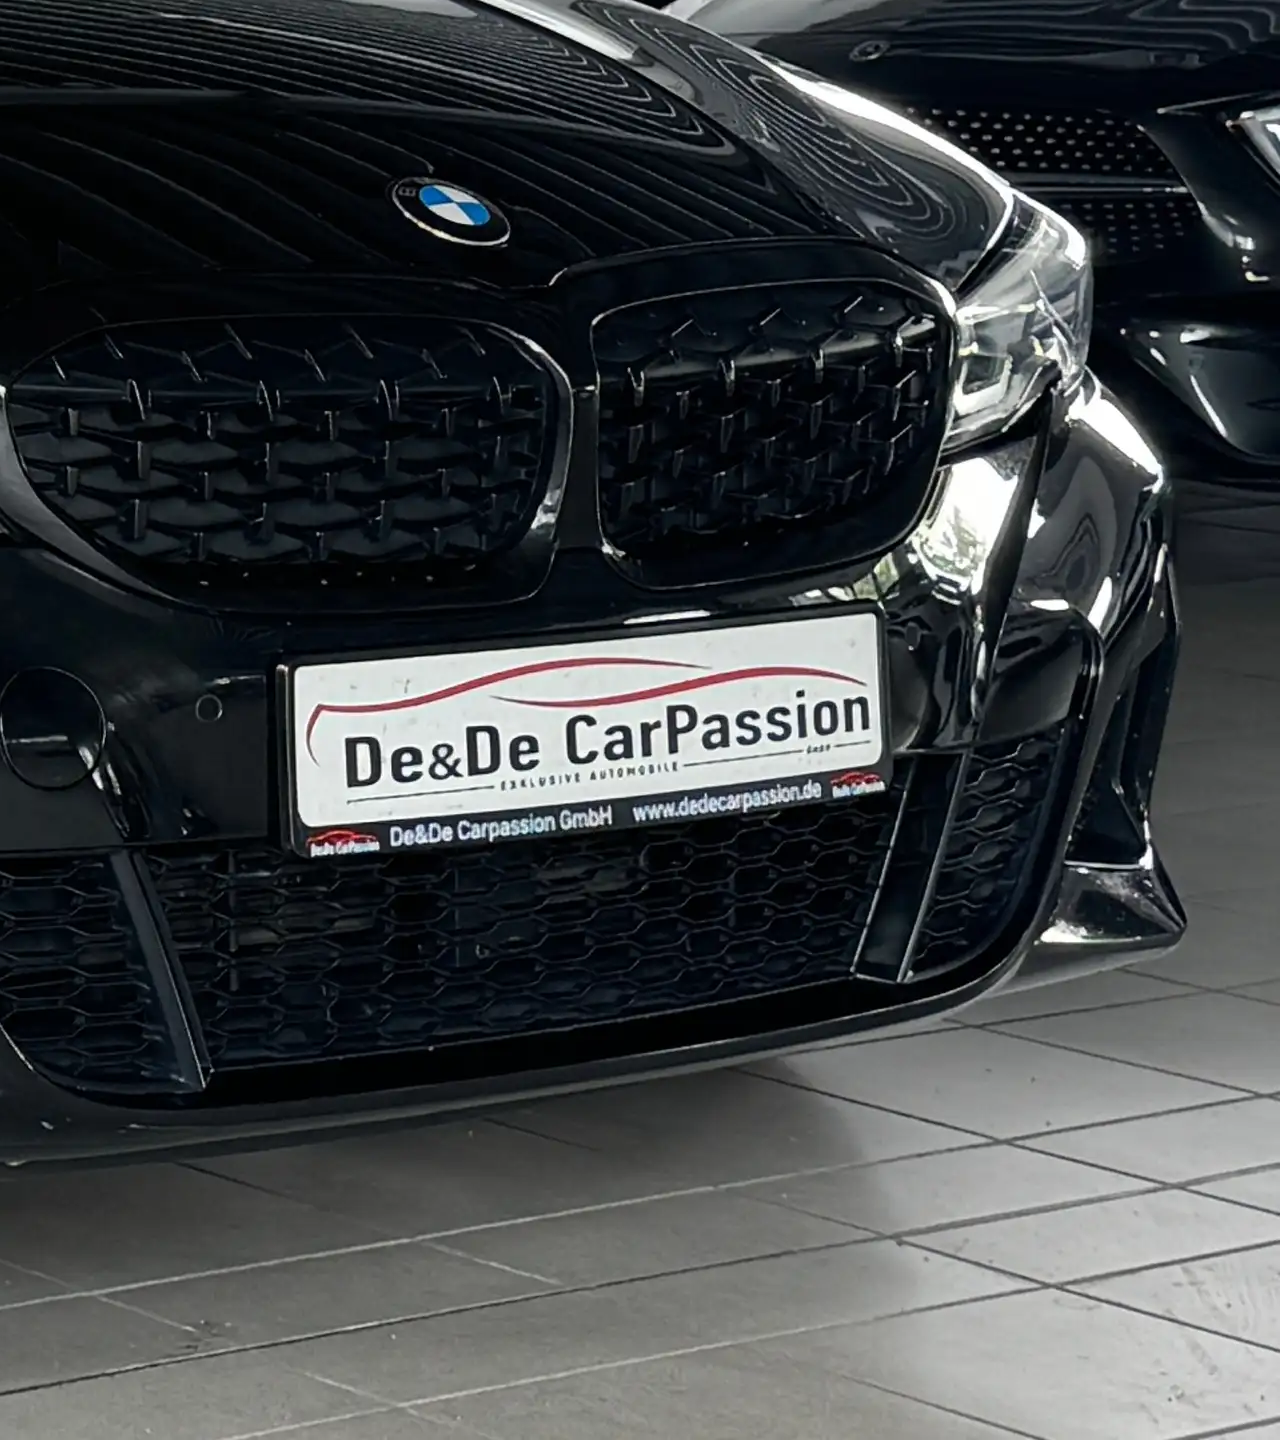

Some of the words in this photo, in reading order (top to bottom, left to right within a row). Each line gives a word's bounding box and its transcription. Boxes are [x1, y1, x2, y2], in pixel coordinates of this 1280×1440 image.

[344, 725, 541, 789] De&De
[565, 689, 871, 765] CarPassion
[389, 822, 454, 848] De&De
[457, 811, 557, 843] Carpassion
[559, 804, 613, 831] GmbH
[632, 778, 822, 822] www.dedecarpassion.de
